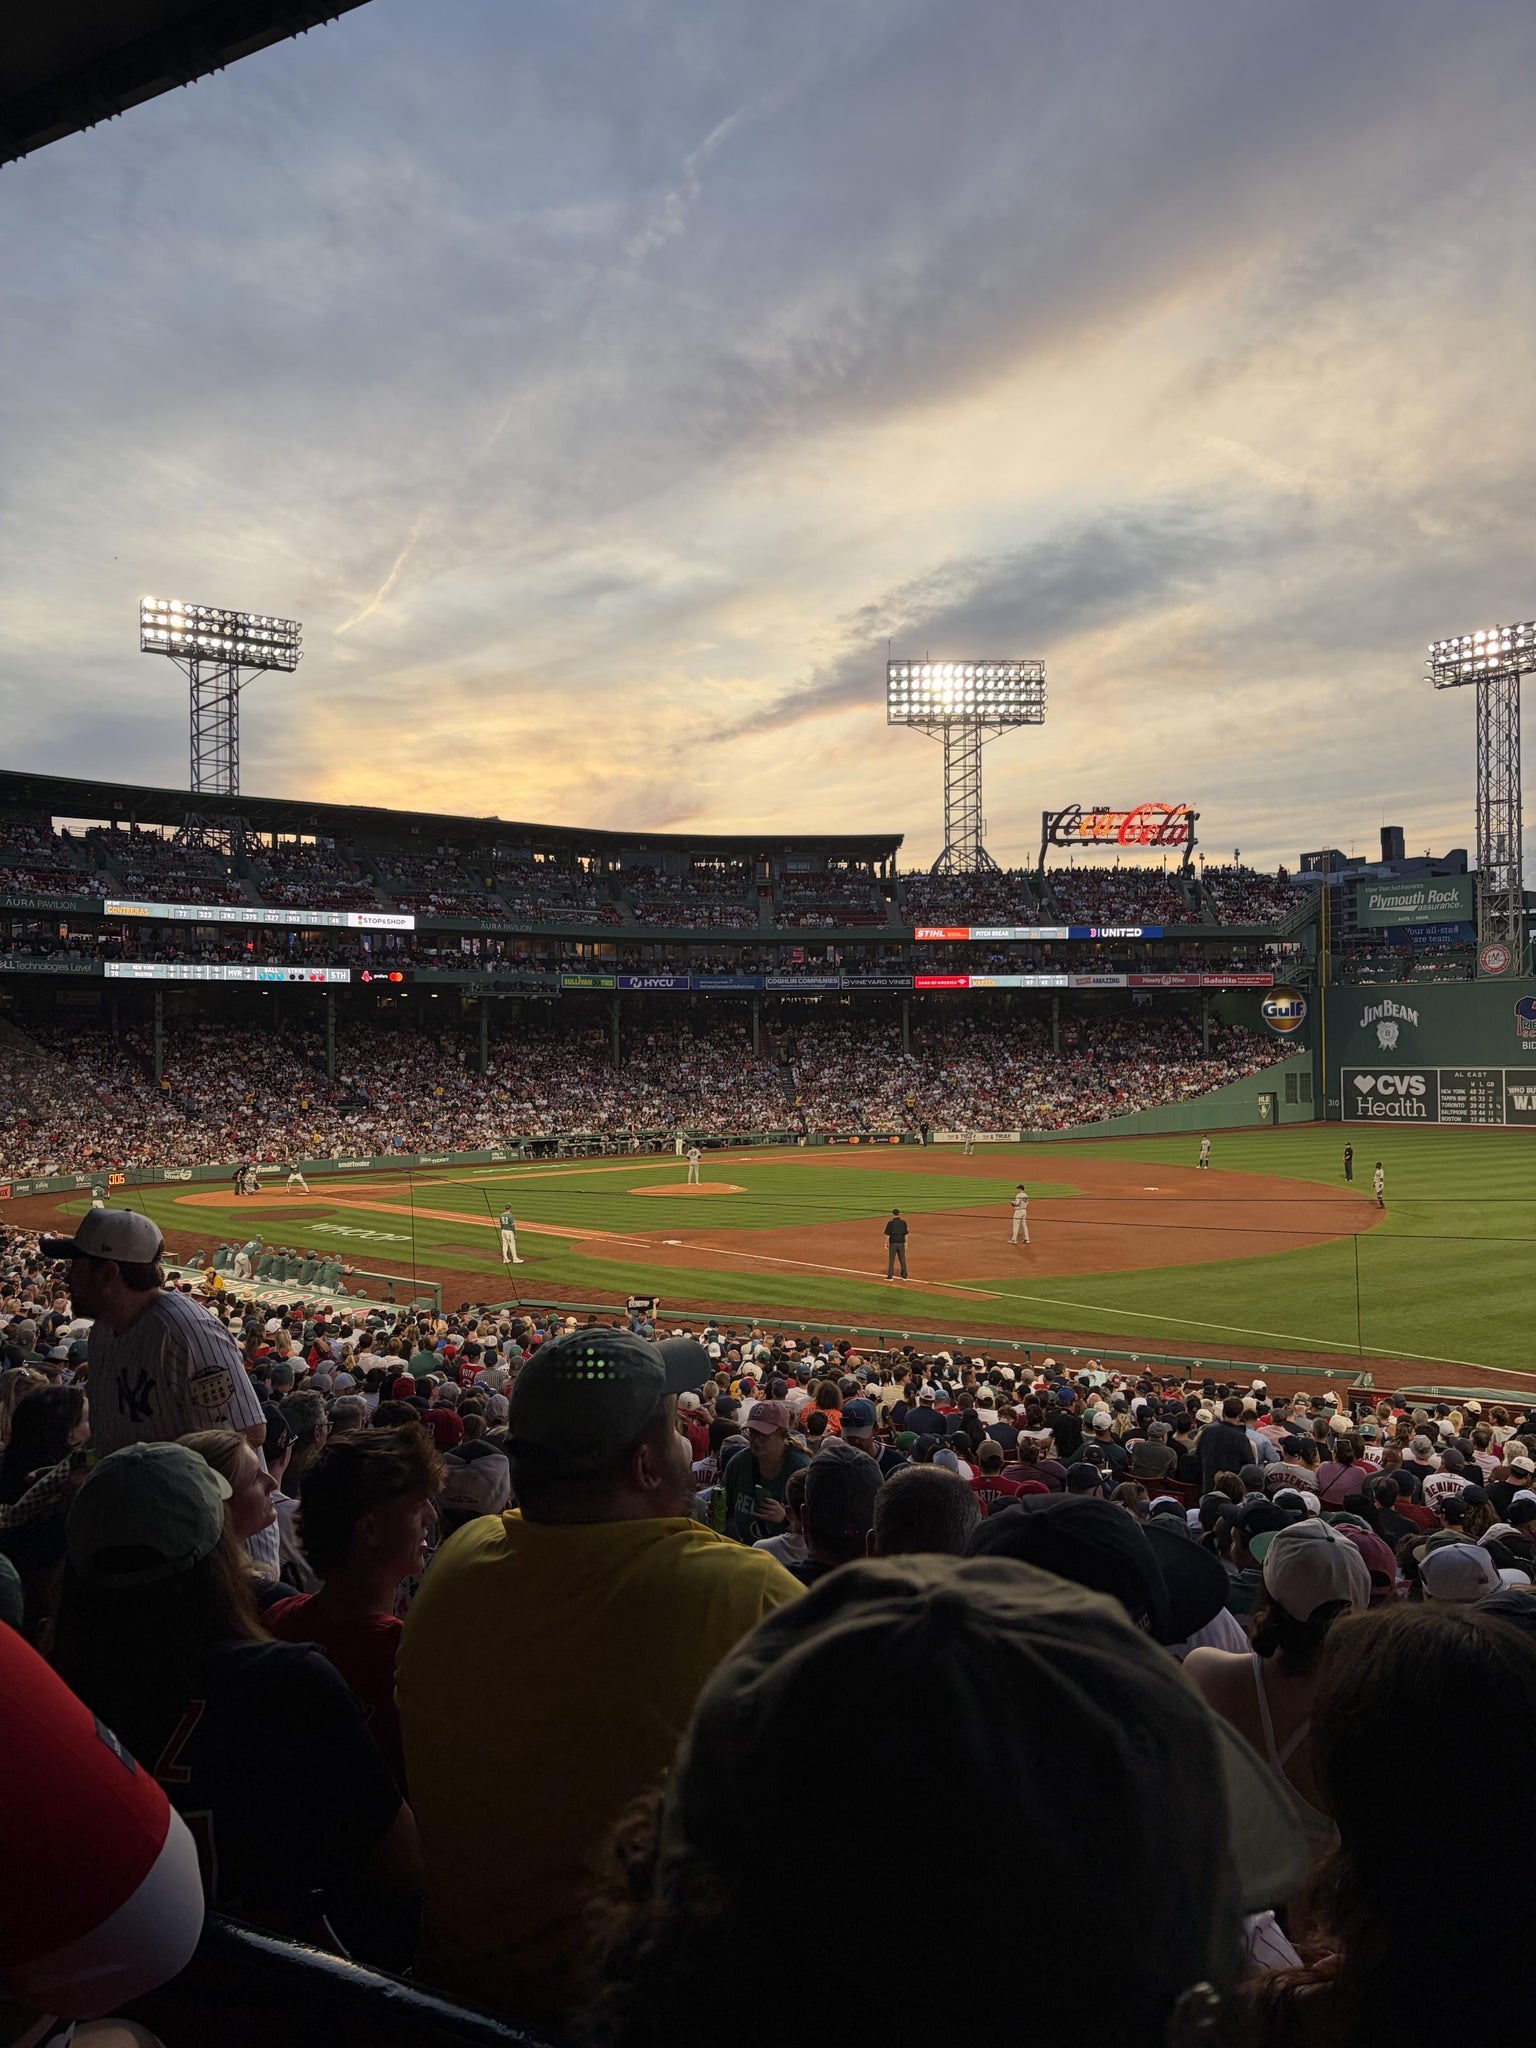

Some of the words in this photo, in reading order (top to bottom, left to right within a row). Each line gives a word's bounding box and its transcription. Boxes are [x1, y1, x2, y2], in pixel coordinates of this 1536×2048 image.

[37, 900, 76, 910] PAVILION
[1369, 890, 1424, 909] Plymouth
[1428, 888, 1460, 903] Rock
[107, 906, 149, 916] CONTRERAS
[504, 924, 532, 932] PAVILION
[1102, 928, 1143, 938] UNITED
[16, 962, 69, 971] Technologies
[70, 962, 92, 972] Level
[564, 978, 592, 986] SULLIVAN
[1262, 1002, 1305, 1018] Gulf
[1360, 1004, 1384, 1028] JIM
[1383, 1000, 1420, 1027] BEAM
[1376, 1074, 1426, 1096] CVS
[1356, 1096, 1427, 1117] Health
[302, 1223, 412, 1241] WHOOP
